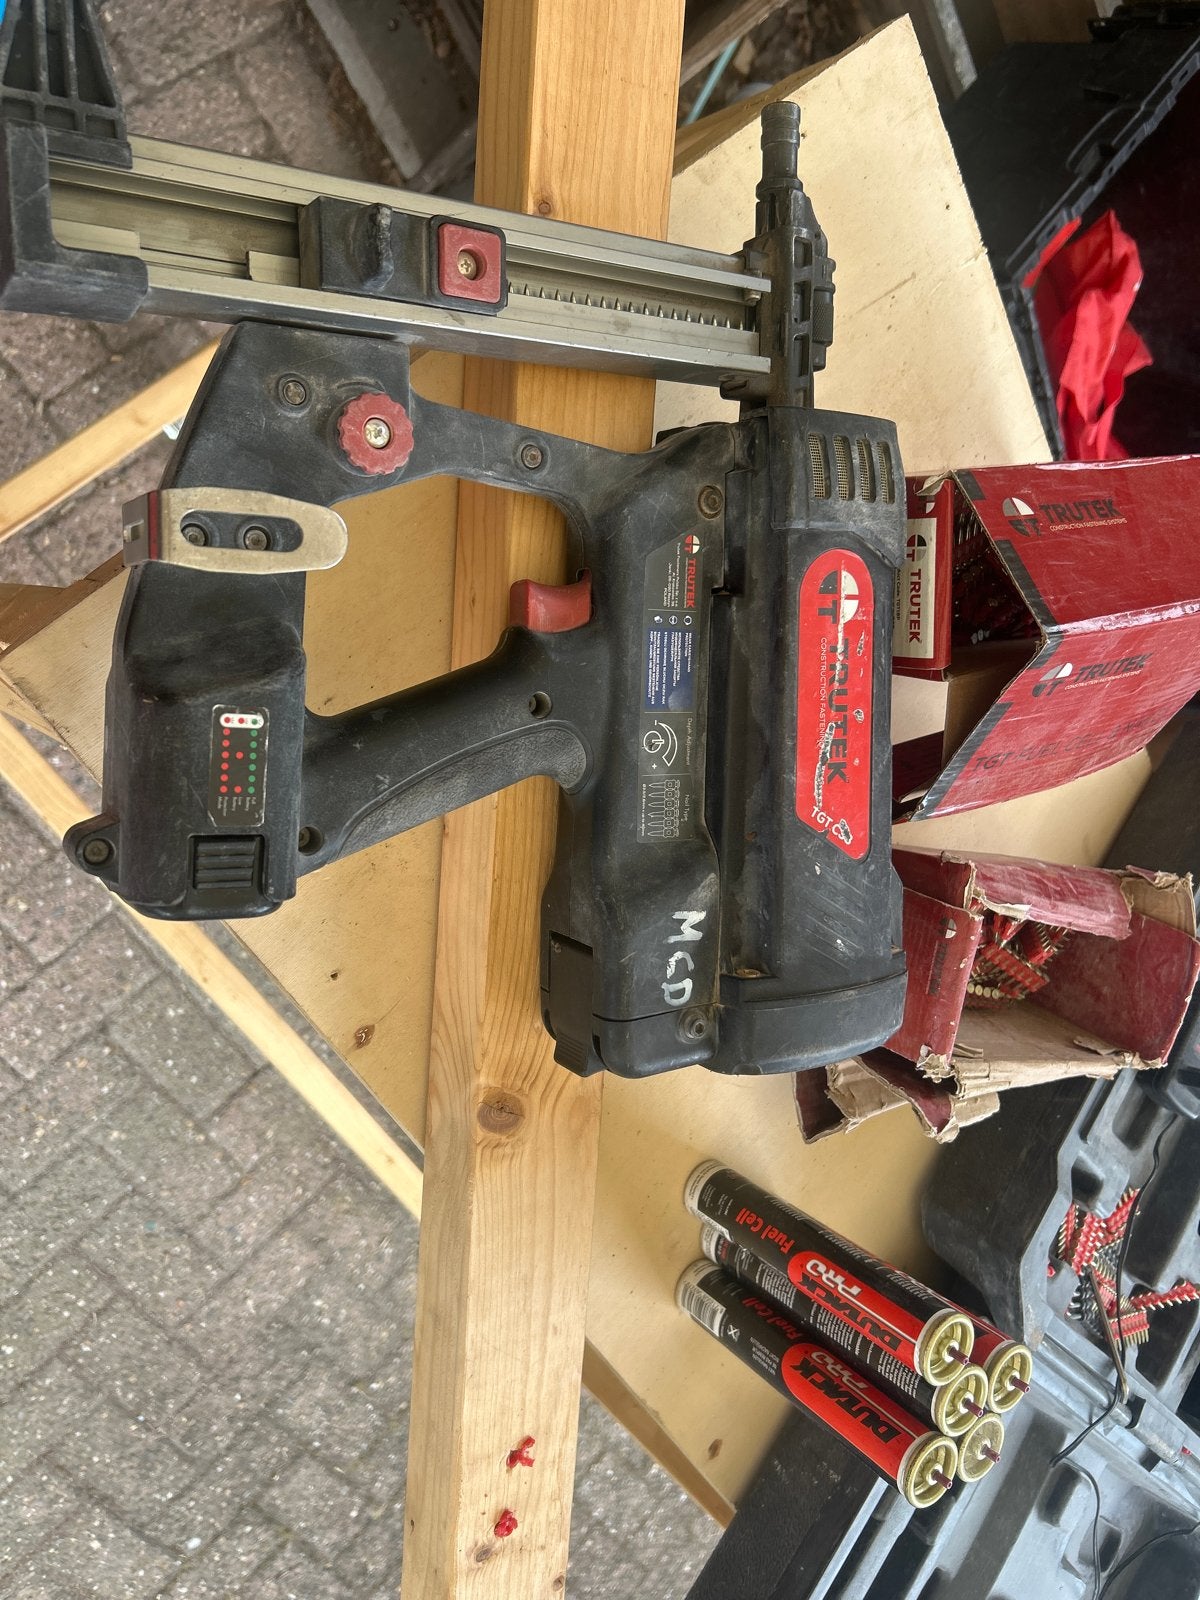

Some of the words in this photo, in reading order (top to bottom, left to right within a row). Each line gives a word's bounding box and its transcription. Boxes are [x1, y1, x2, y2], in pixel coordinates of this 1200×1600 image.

[1040, 499, 1122, 523] TRUTEK
[686, 558, 696, 608] TRUTEK
[909, 568, 922, 643] TRUTEK
[1074, 652, 1153, 682] TRUTEK
[828, 638, 849, 784] TRUTEK
[811, 806, 834, 827] TGT
[736, 1208, 763, 1232] Cell
[761, 1225, 795, 1254] Fuel
[806, 1259, 862, 1296] PRO
[742, 1298, 773, 1317] Cell
[798, 1272, 902, 1351] DUTACK
[767, 1317, 802, 1339] Fuel
[811, 1352, 868, 1388] PRO
[790, 1357, 902, 1444] DUTACK
